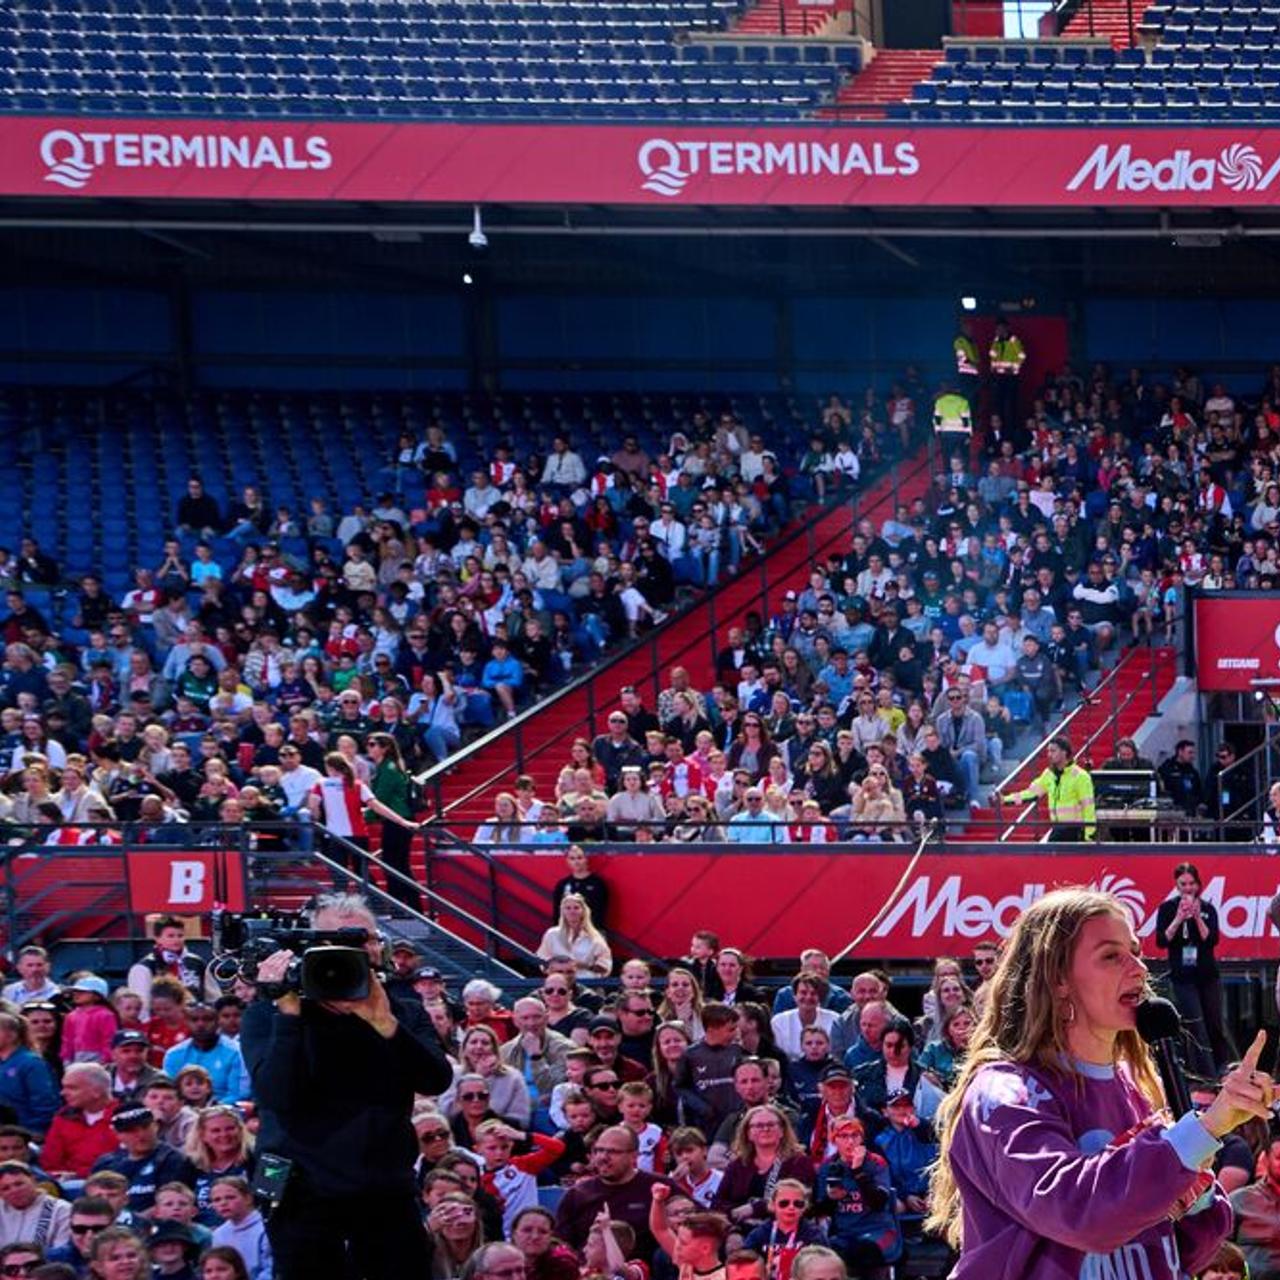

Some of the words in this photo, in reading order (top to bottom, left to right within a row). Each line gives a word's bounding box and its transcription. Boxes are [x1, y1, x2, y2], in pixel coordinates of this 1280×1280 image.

[40, 130, 332, 188] QTERMINALS
[638, 138, 920, 196] QTERMINALS
[168, 861, 205, 903] B
